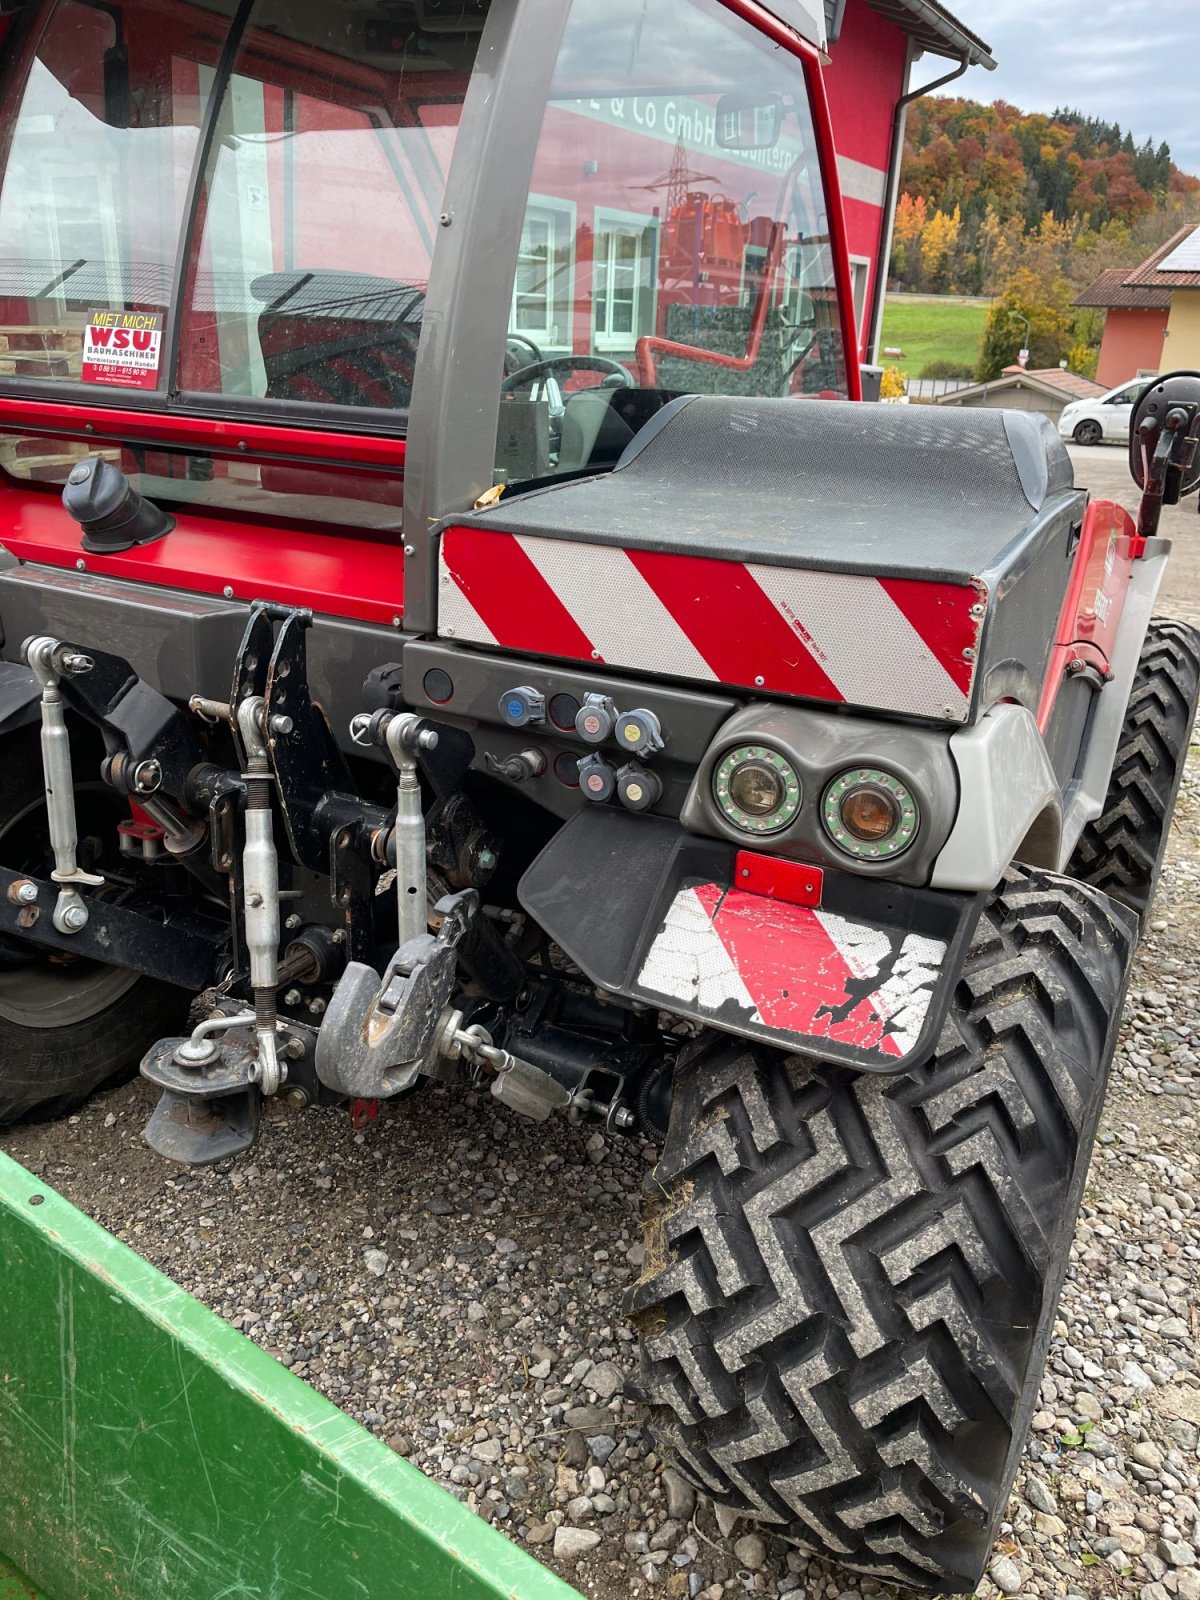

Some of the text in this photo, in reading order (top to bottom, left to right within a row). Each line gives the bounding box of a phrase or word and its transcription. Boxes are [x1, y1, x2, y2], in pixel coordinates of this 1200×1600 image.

[633, 97, 657, 128] Co
[663, 101, 716, 147] GmbH
[92, 312, 157, 330] MIET MICH!
[87, 346, 156, 359] BAUMASCHINEN
[87, 356, 120, 365] Vermietung
